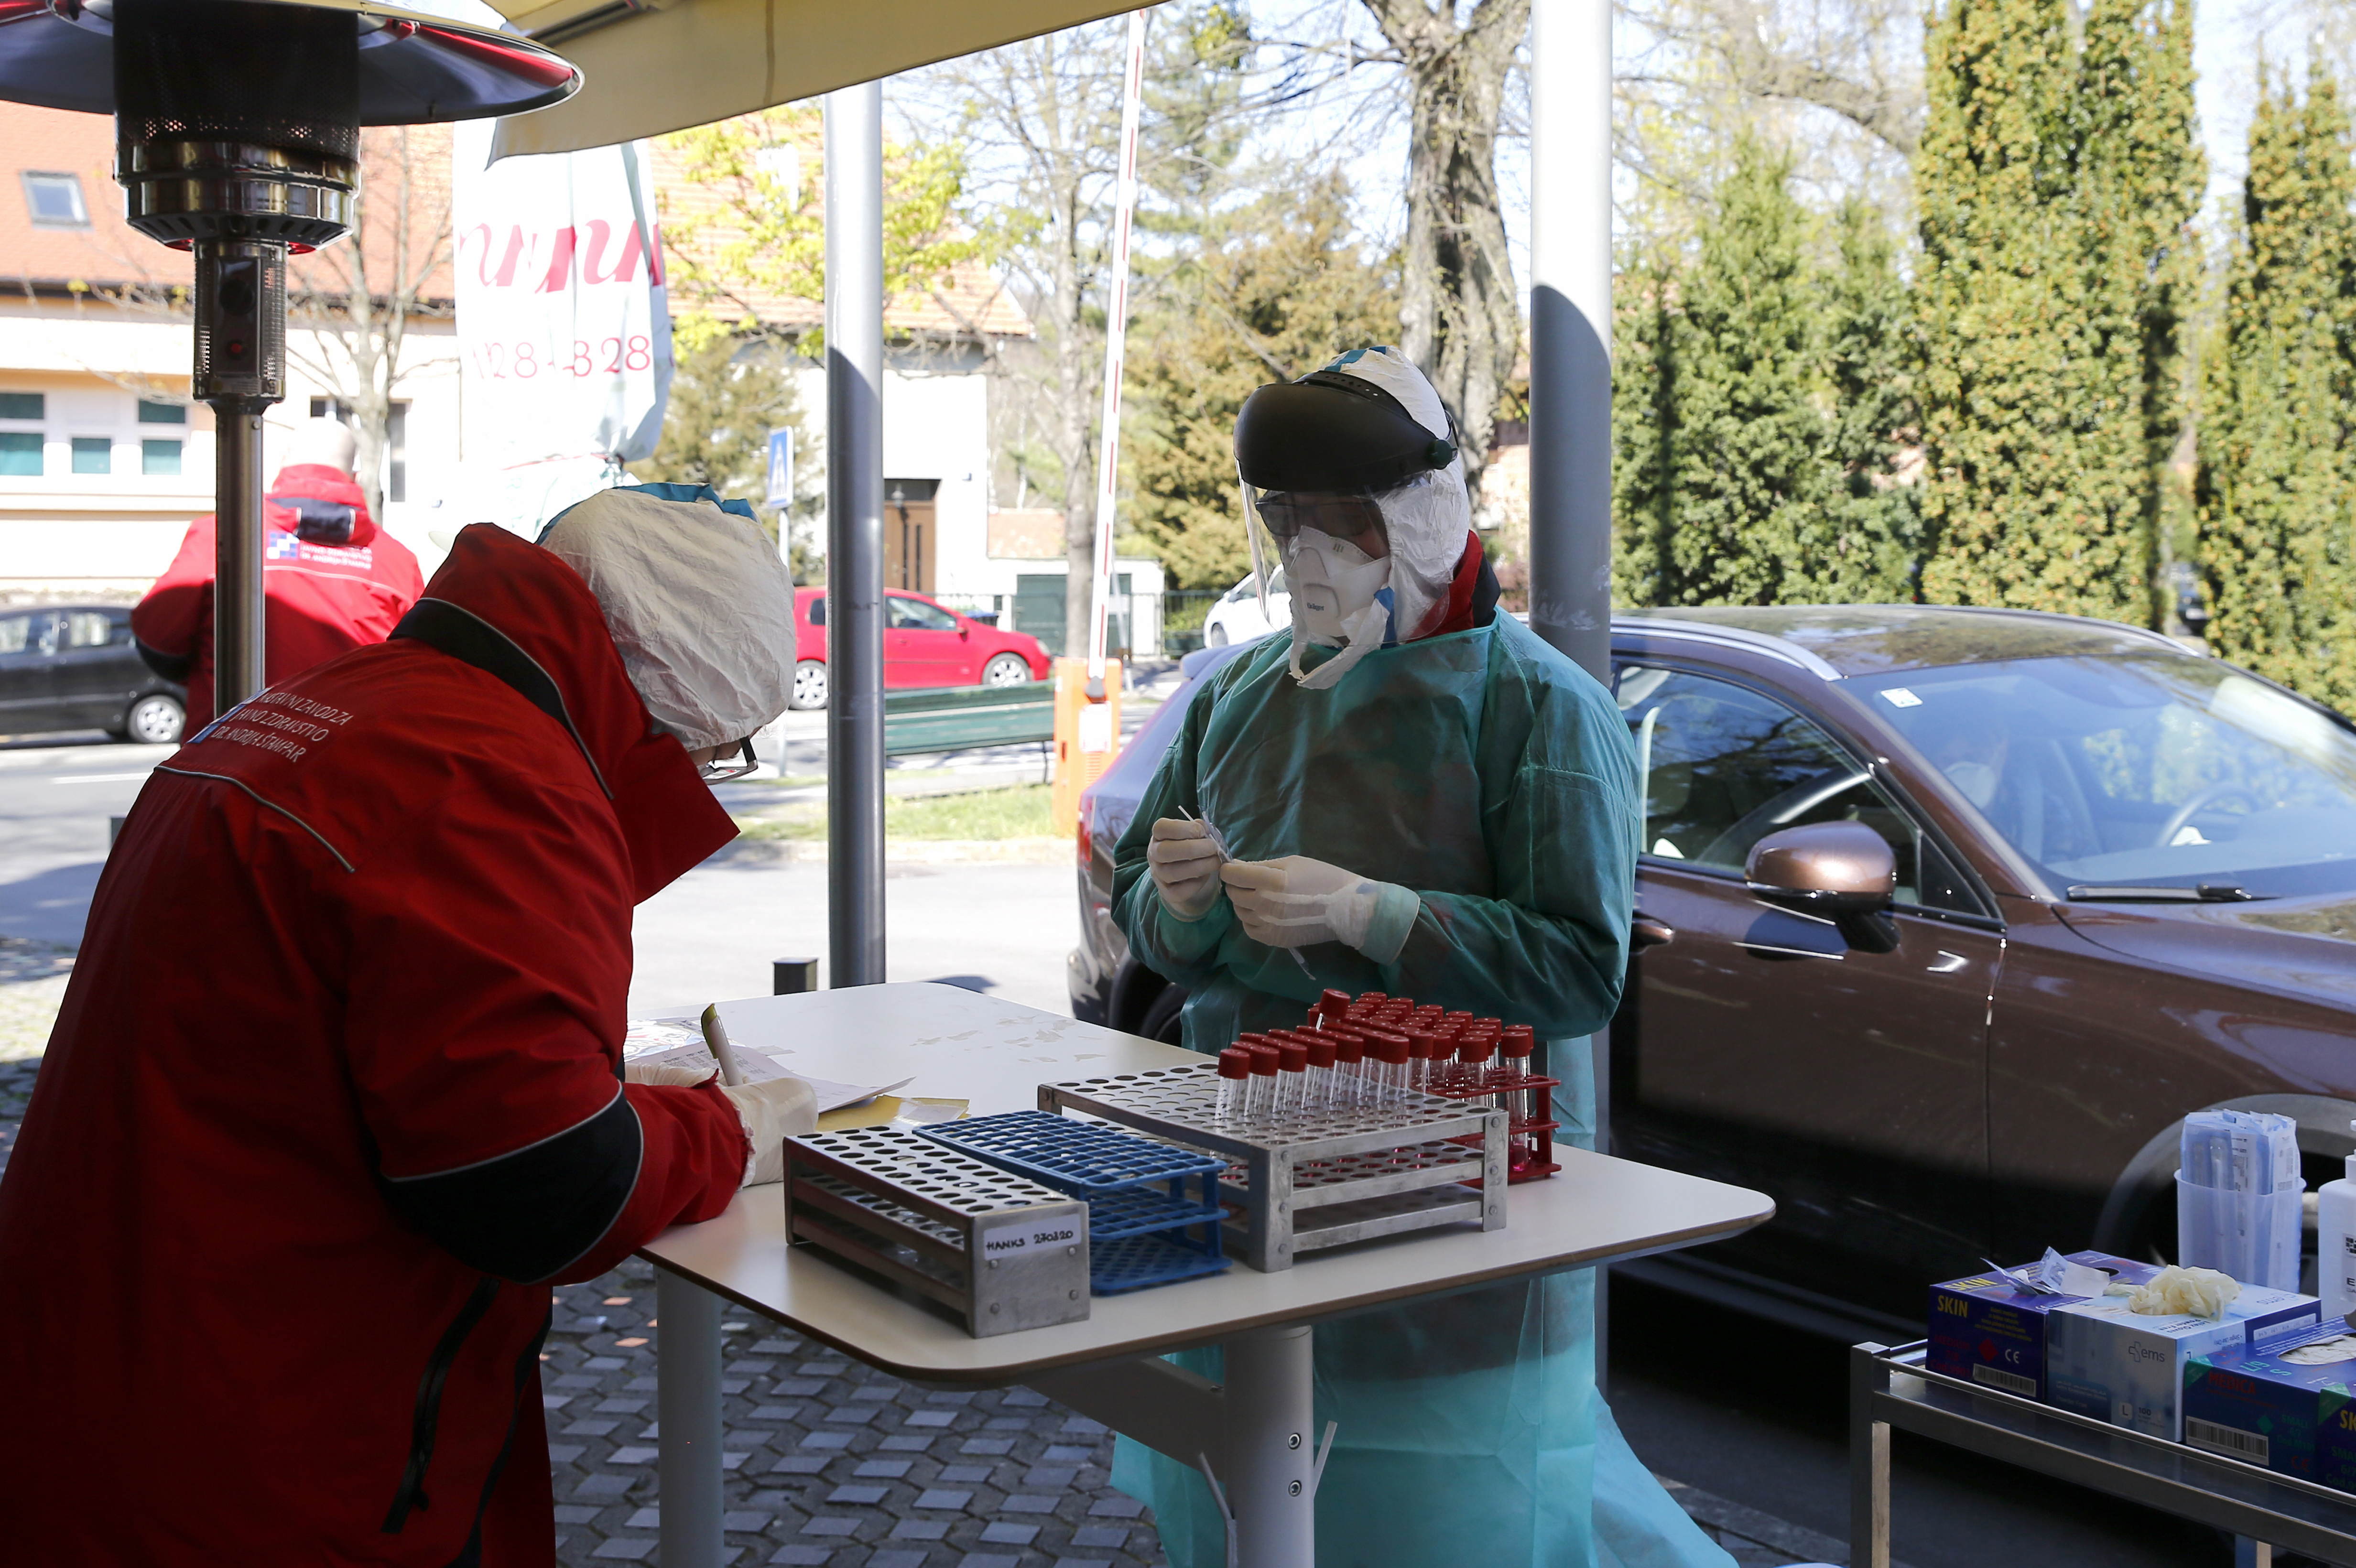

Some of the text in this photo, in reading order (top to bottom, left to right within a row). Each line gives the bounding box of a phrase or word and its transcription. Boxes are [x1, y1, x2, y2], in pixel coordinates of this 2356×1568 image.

[295, 699, 338, 719] ZAVOD
[329, 712, 354, 725] ZA
[228, 708, 329, 741] JAVNO ZDRAVSTVO
[261, 732, 306, 763] ŠTAMPAR
[986, 1238, 1025, 1251] HANKS
[1944, 1277, 1998, 1291] SKIN
[1937, 1295, 1968, 1318] SKIN
[2141, 1350, 2165, 1363] ems
[2208, 1372, 2256, 1395] MEDICA
[2122, 1404, 2128, 1416] L
[2138, 1406, 2151, 1416] 100
[2340, 1409, 2356, 1431] SK
